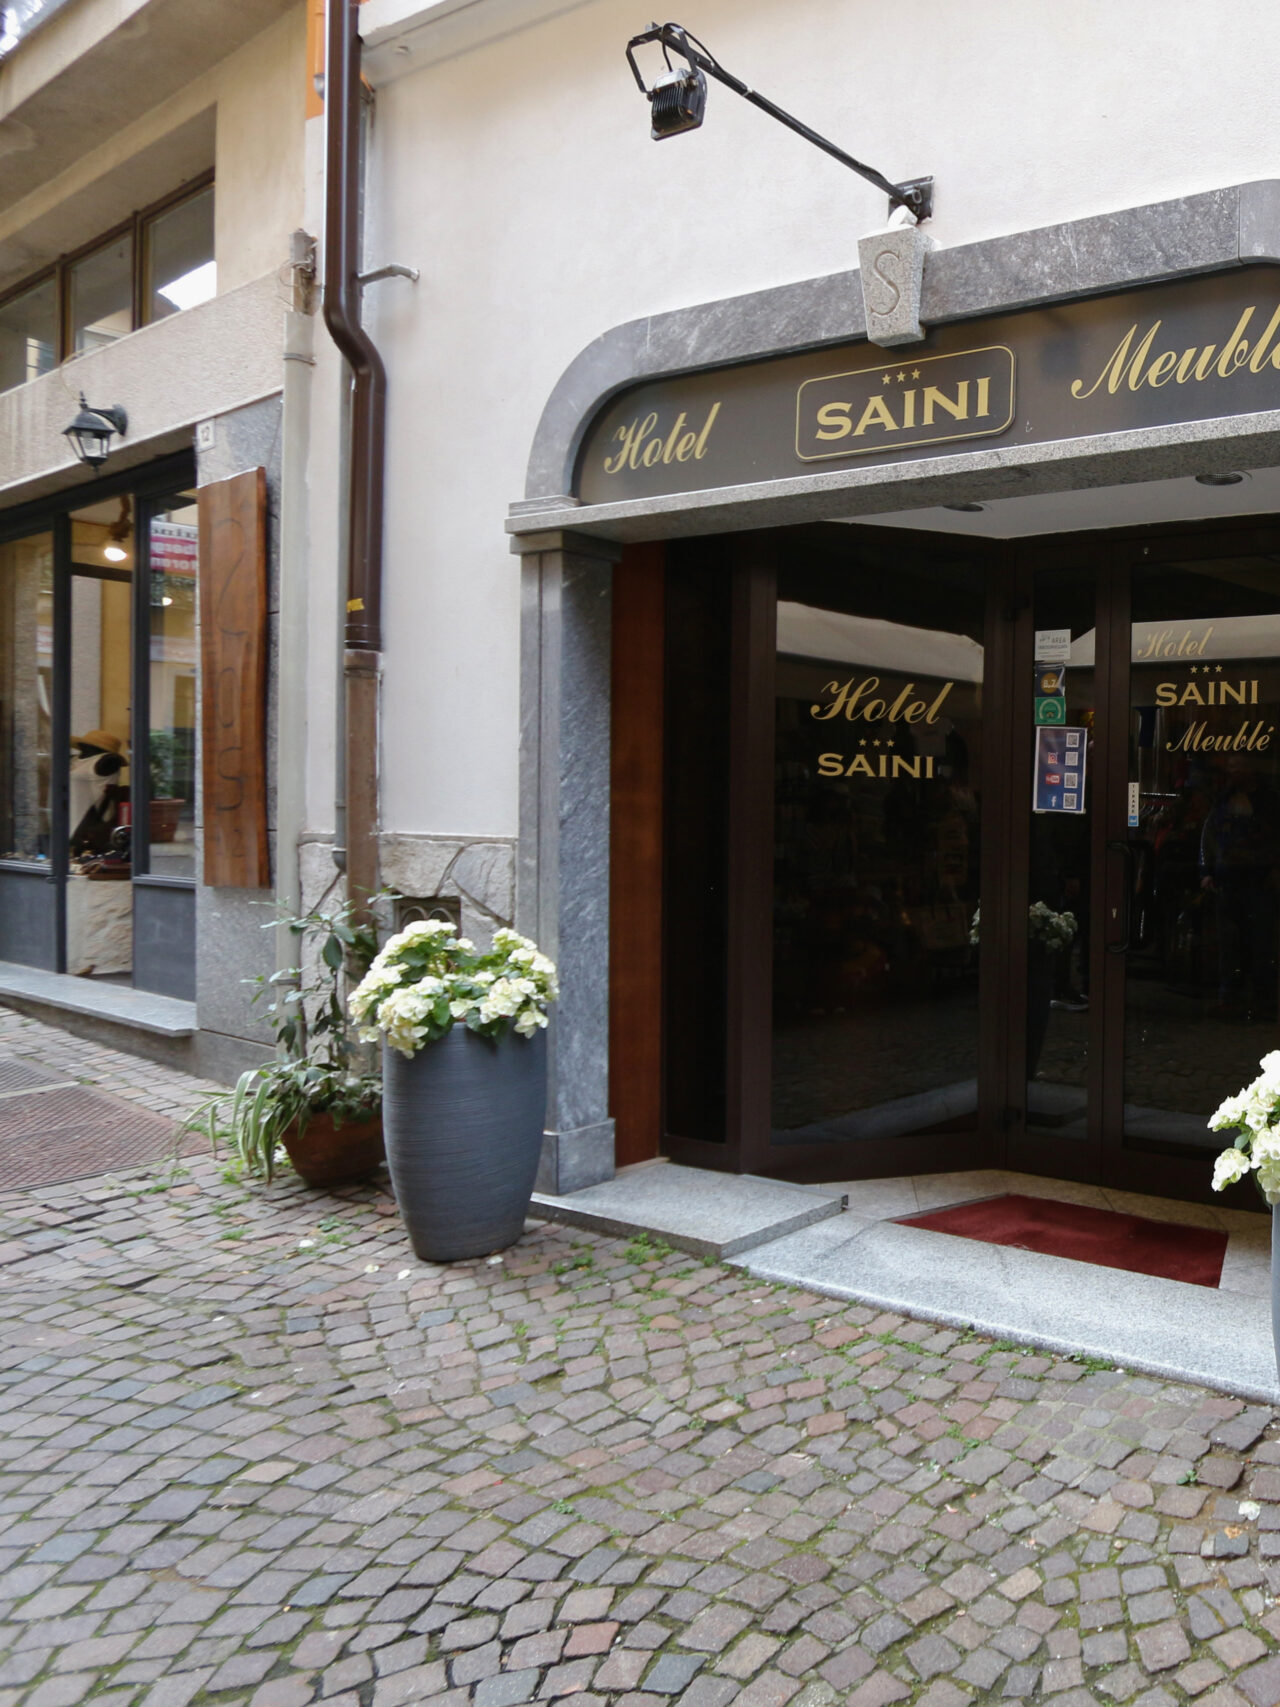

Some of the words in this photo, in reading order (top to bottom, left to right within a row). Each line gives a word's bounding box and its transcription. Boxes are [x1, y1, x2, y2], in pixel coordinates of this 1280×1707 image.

[603, 402, 721, 475] Hotel
[815, 376, 992, 442] SAINI
[1137, 626, 1214, 658] Hotel
[810, 676, 954, 725] Hotel
[1155, 680, 1259, 707] SAINI
[1165, 720, 1275, 752] Meublé
[817, 753, 934, 779] SAINI
